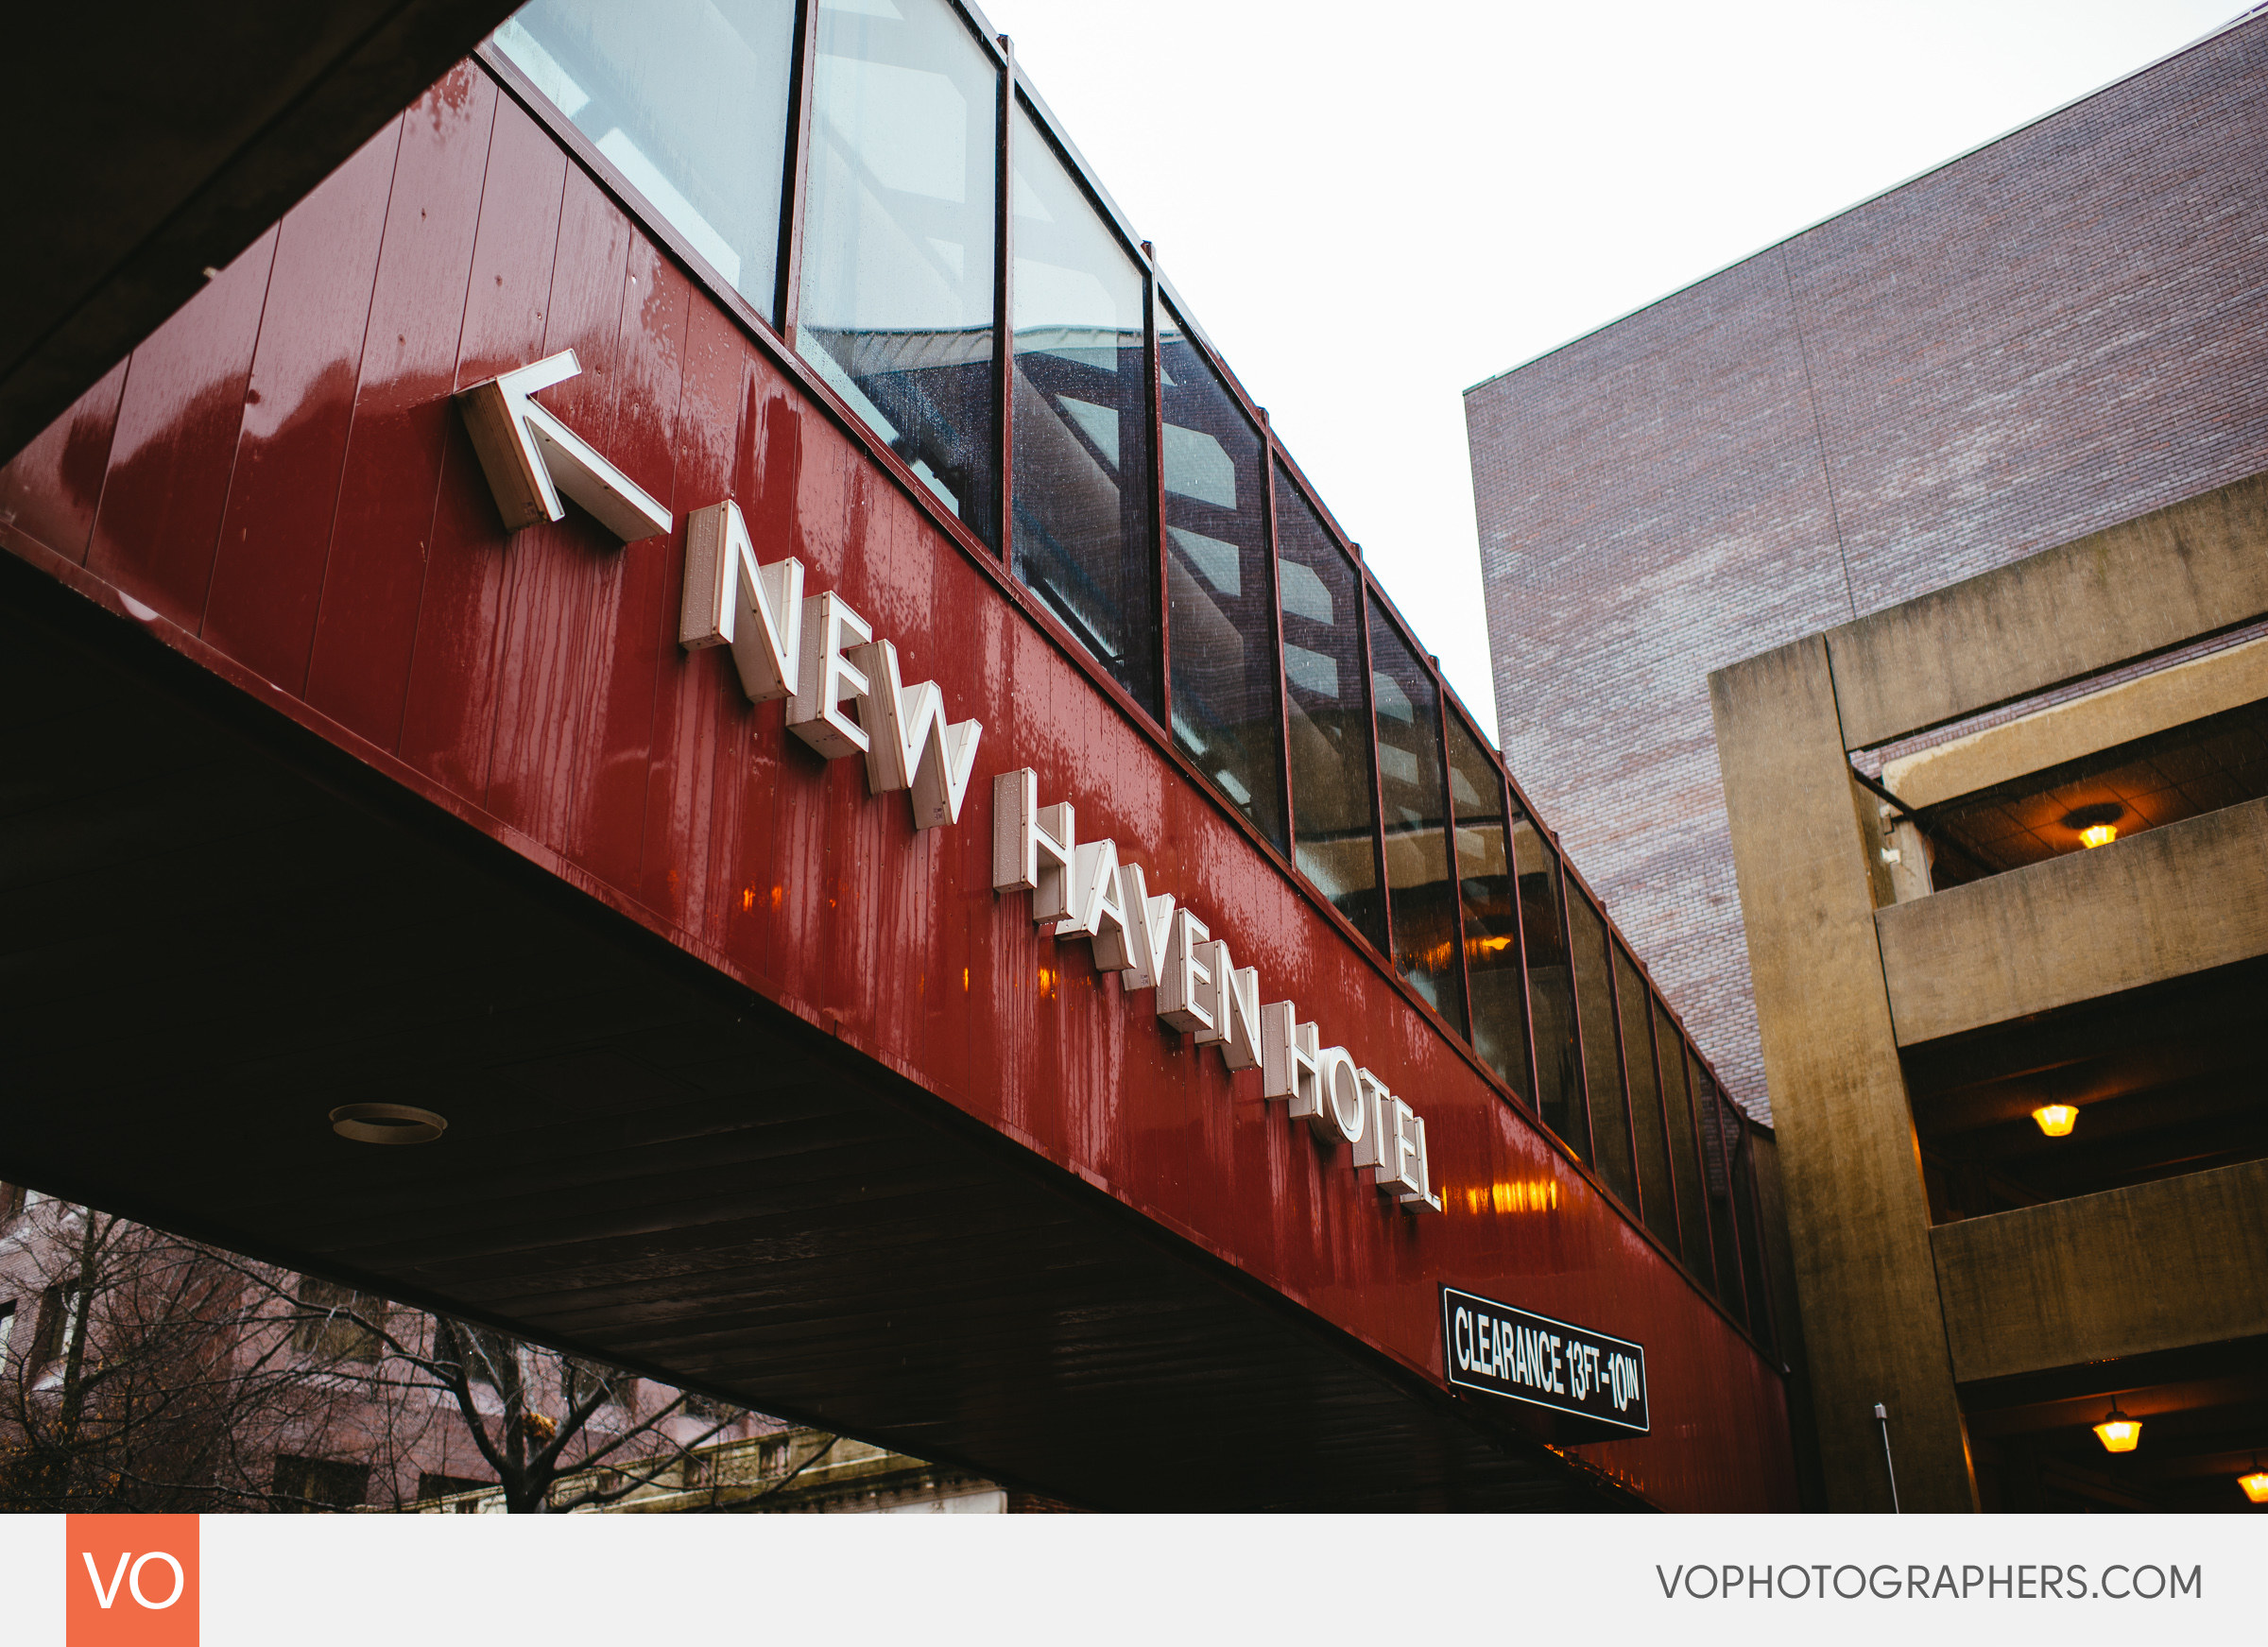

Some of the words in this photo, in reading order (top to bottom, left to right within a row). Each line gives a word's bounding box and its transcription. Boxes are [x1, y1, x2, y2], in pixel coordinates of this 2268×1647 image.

[682, 499, 984, 830] NEW
[996, 767, 1263, 1070] HAVEN
[1263, 1000, 1441, 1213] HOTEL
[1455, 1306, 1564, 1394] CLEARANCE
